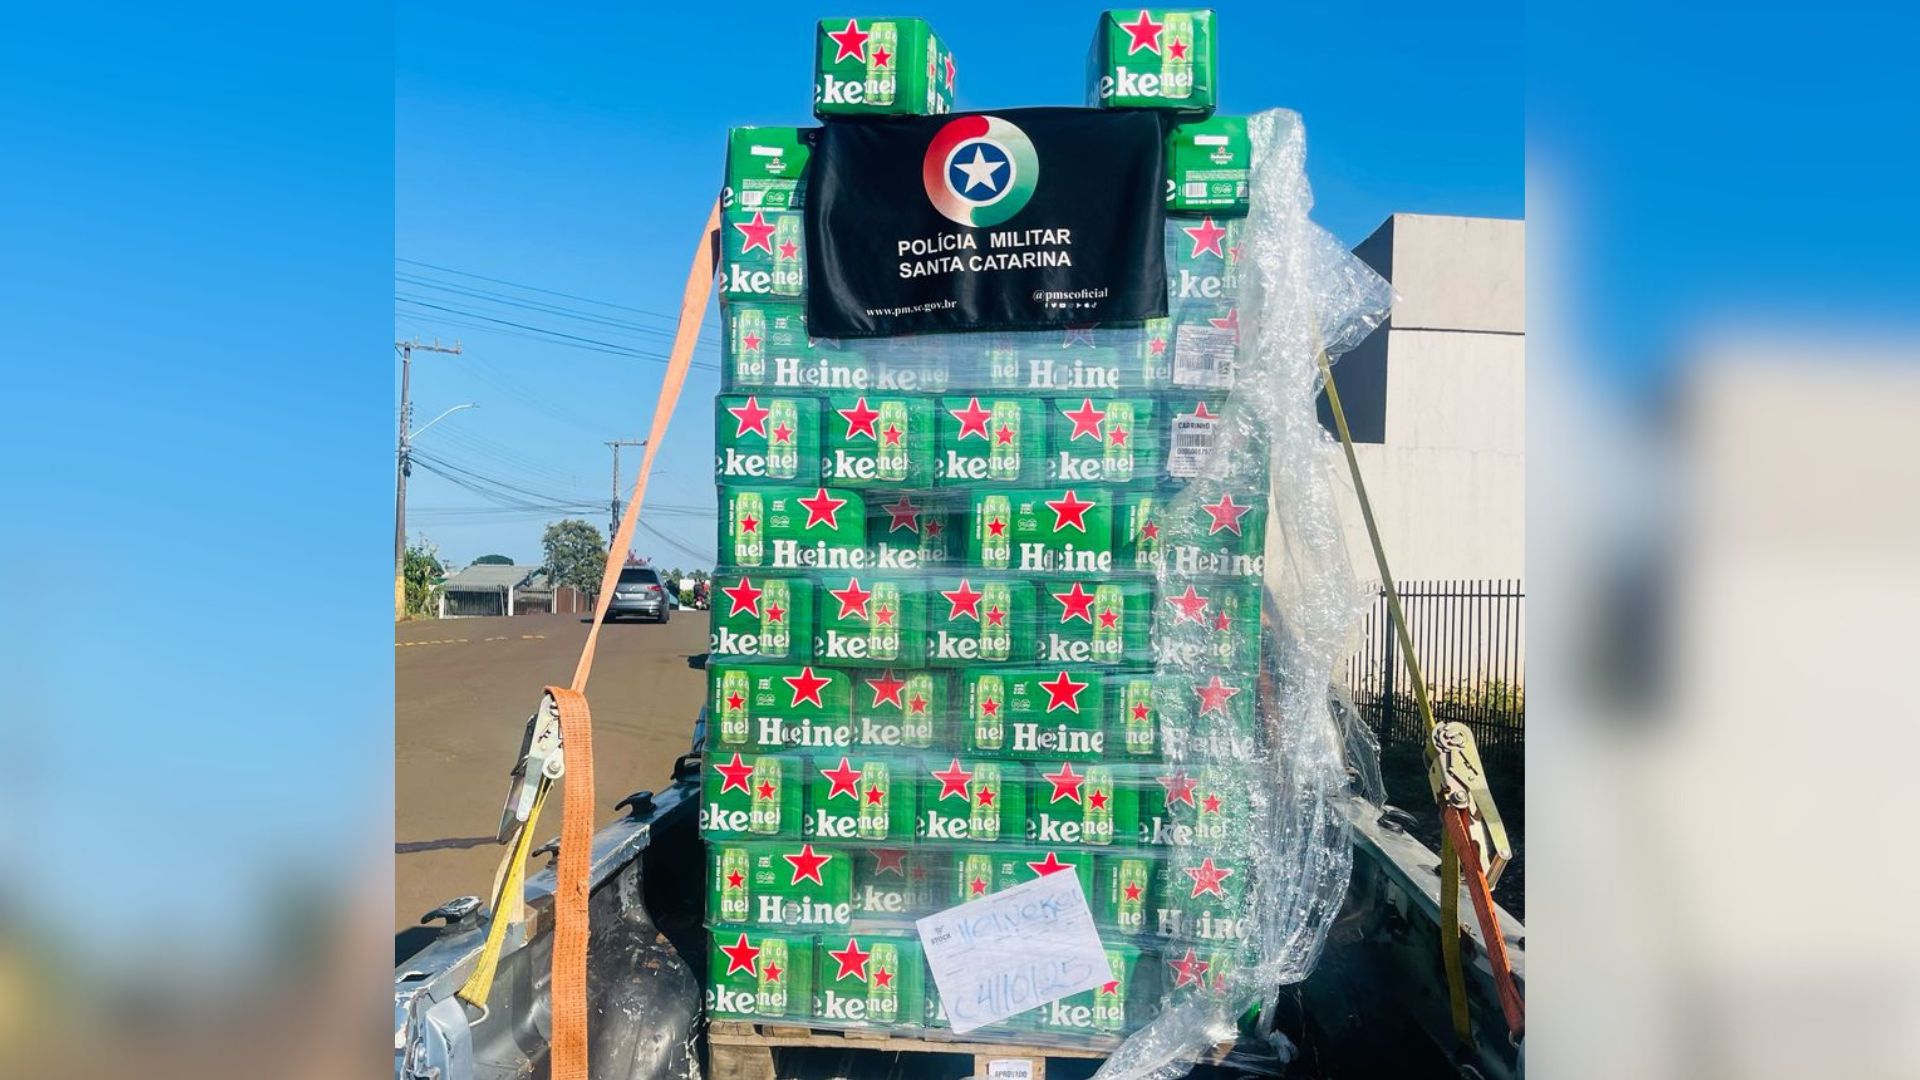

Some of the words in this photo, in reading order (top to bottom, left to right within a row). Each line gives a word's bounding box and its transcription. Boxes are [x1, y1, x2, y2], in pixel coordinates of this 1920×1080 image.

[898, 232, 977, 256] POLÍCIA
[990, 228, 1072, 248] MILITAR
[899, 257, 964, 279] SANTA
[969, 251, 1072, 272] CATARINA
[1033, 286, 1108, 303] @pmscoficial
[866, 299, 958, 317] www.pm.sc.gov.br
